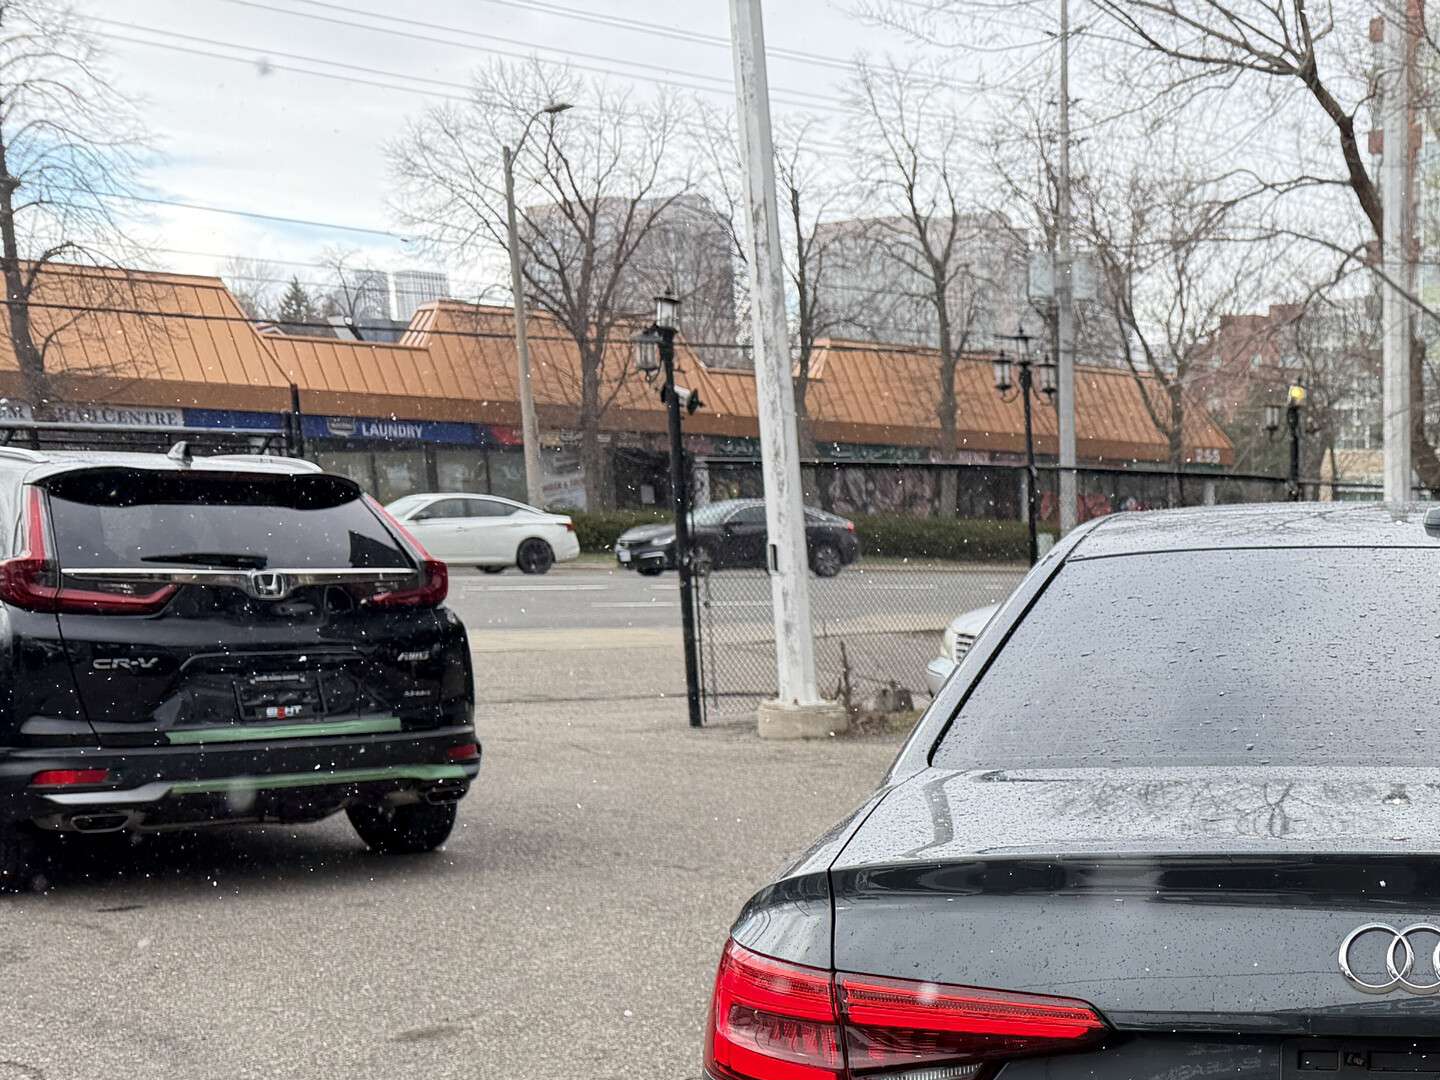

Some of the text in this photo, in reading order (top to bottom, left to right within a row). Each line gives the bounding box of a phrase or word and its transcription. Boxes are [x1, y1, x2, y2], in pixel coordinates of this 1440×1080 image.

[102, 406, 178, 425] CENTRE
[361, 423, 423, 439] LAUNDRY
[93, 657, 158, 669] CR-V
